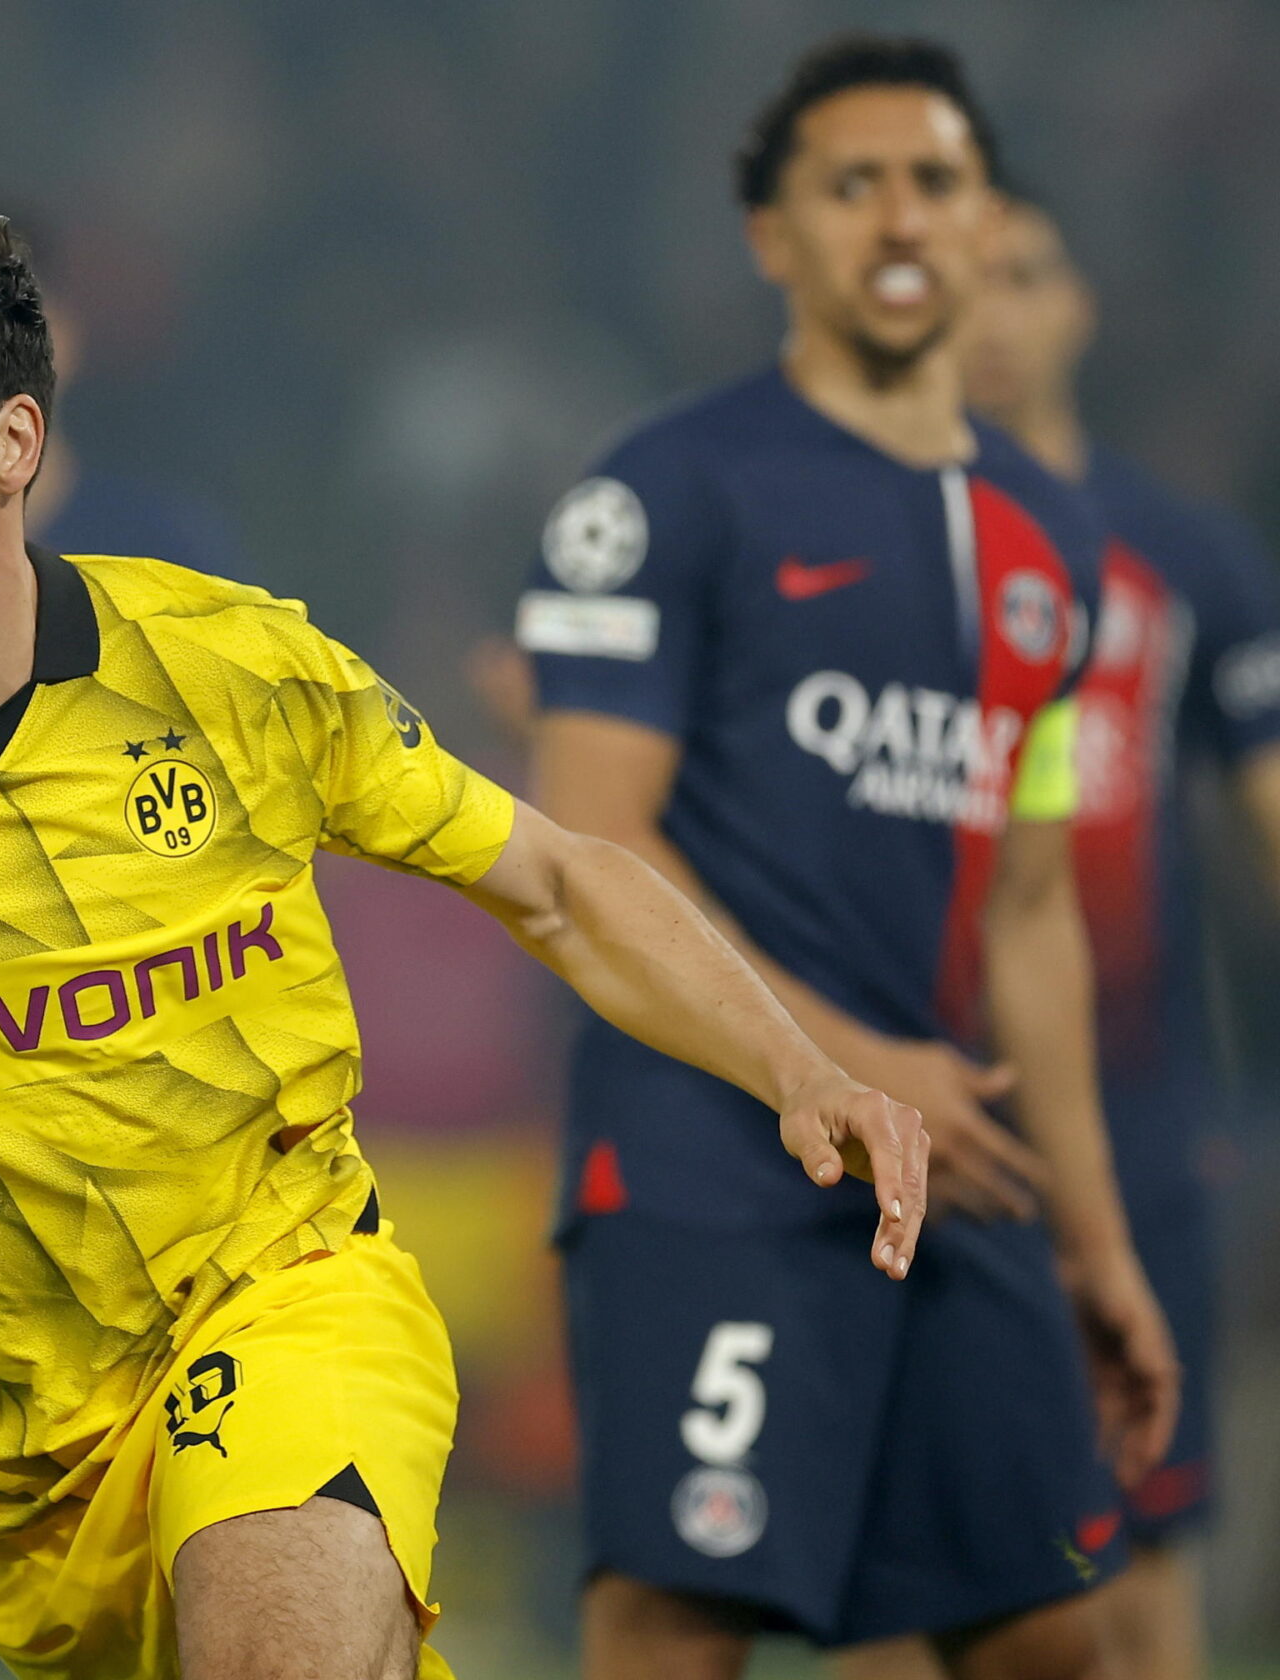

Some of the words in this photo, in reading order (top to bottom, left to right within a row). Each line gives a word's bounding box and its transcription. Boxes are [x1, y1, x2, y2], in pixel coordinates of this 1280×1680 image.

[134, 767, 207, 835] BVB
[164, 826, 191, 849] 09
[679, 1320, 774, 1467] 5
